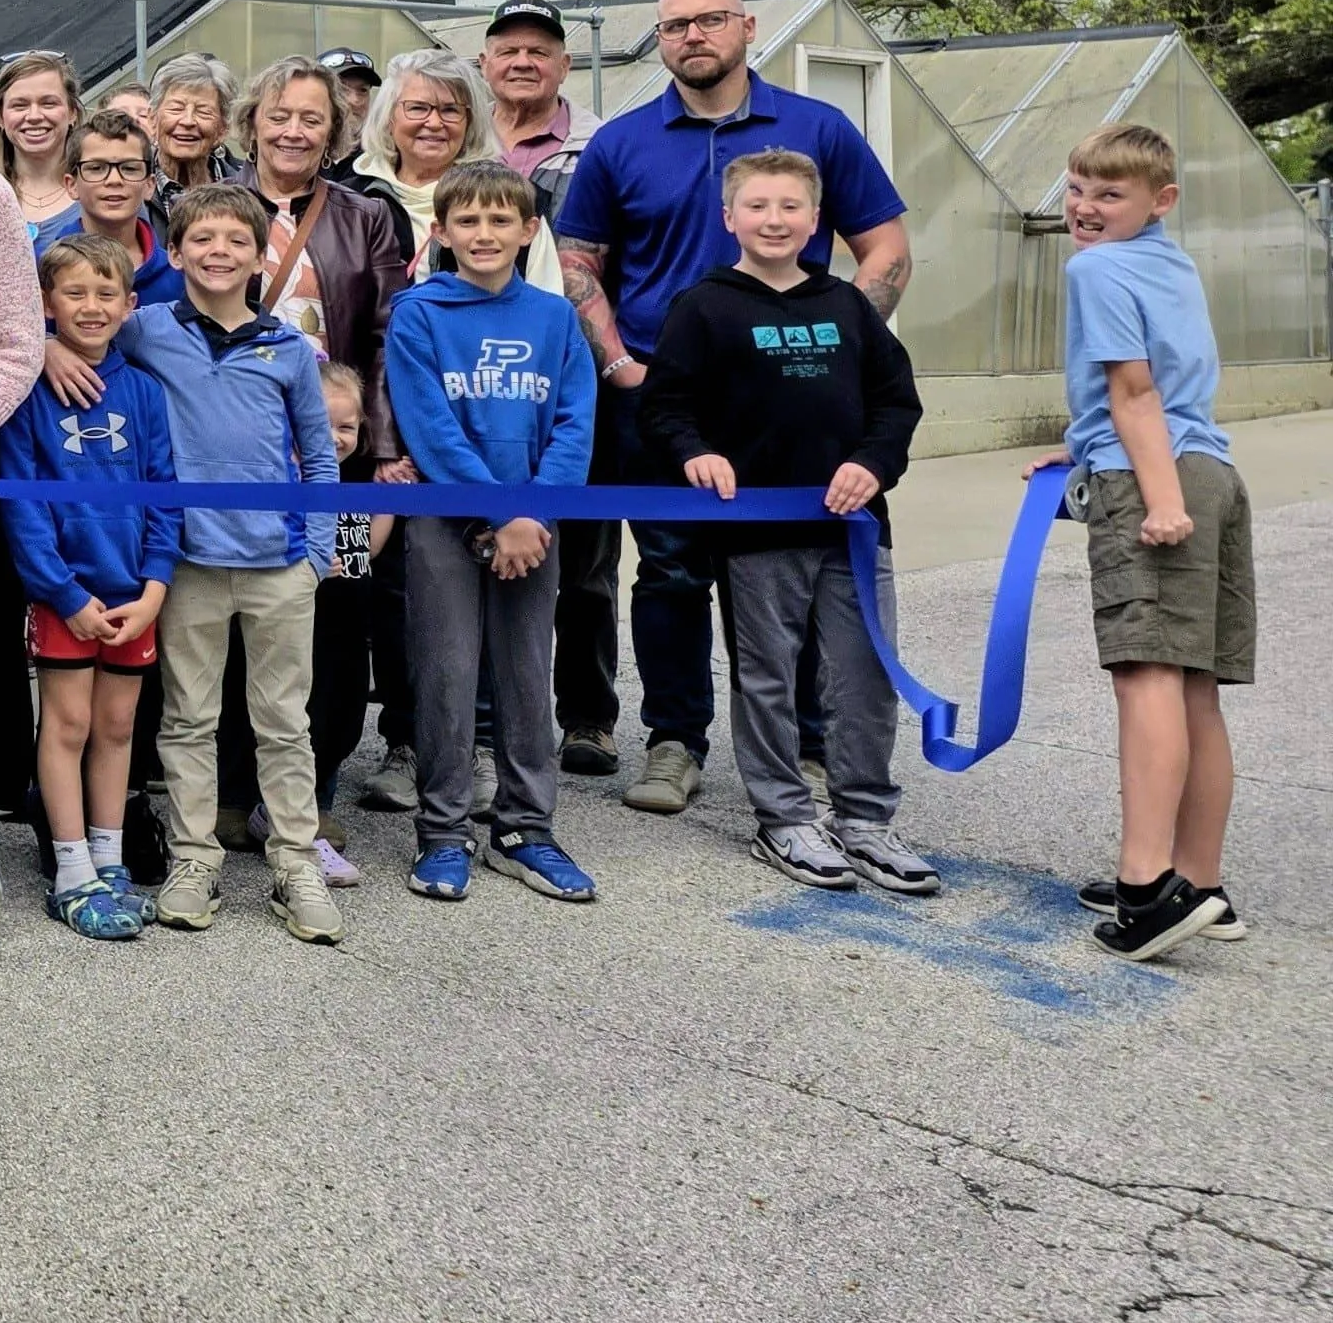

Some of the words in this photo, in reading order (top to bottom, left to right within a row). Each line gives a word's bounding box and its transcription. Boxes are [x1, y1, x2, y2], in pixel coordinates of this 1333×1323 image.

[476, 338, 532, 371] P
[443, 370, 551, 404] BLUEJAS
[499, 831, 523, 847] NIKE
